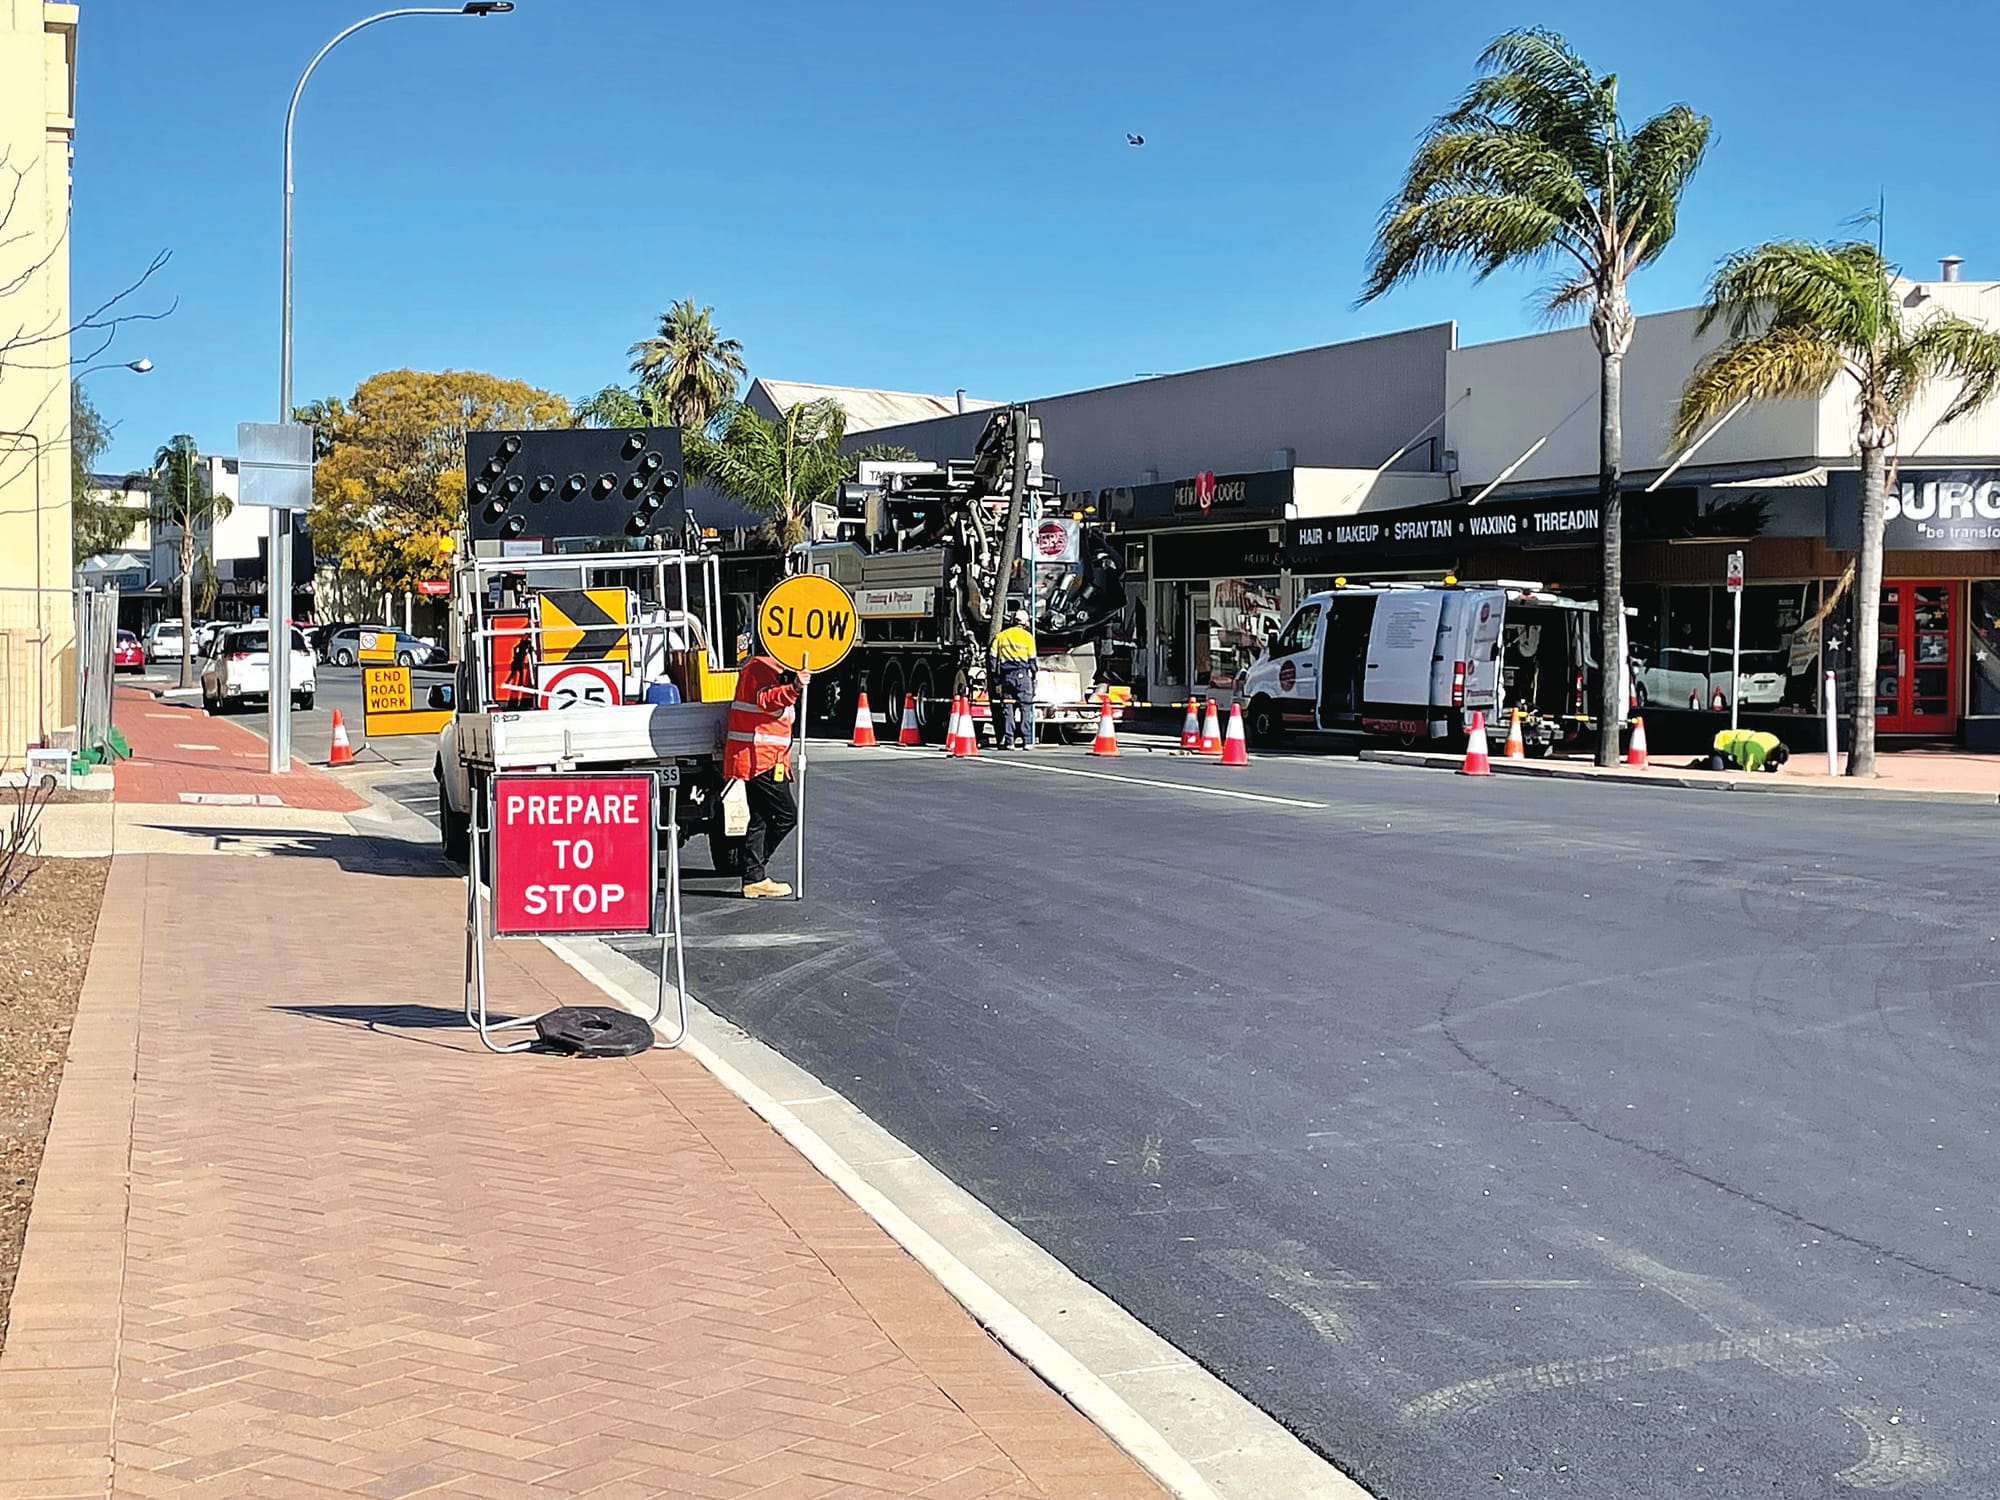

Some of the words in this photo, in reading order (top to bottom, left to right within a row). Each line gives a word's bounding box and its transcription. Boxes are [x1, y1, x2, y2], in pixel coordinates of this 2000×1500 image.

[1212, 481, 1247, 503] COOPER
[1299, 528, 1323, 545] HAIR
[1336, 524, 1379, 543] MAKEUP
[1394, 520, 1430, 540] SPRAY
[1430, 519, 1452, 538] TAN
[1469, 514, 1517, 536] WAXING
[1533, 509, 1599, 532] THREADIN
[767, 605, 850, 641] SLOW
[371, 684, 406, 695] ROAD
[375, 671, 401, 682] END
[371, 697, 407, 709] WORK
[506, 794, 639, 825] PREPARE
[552, 839, 594, 869] TO
[523, 883, 625, 915] STOP
